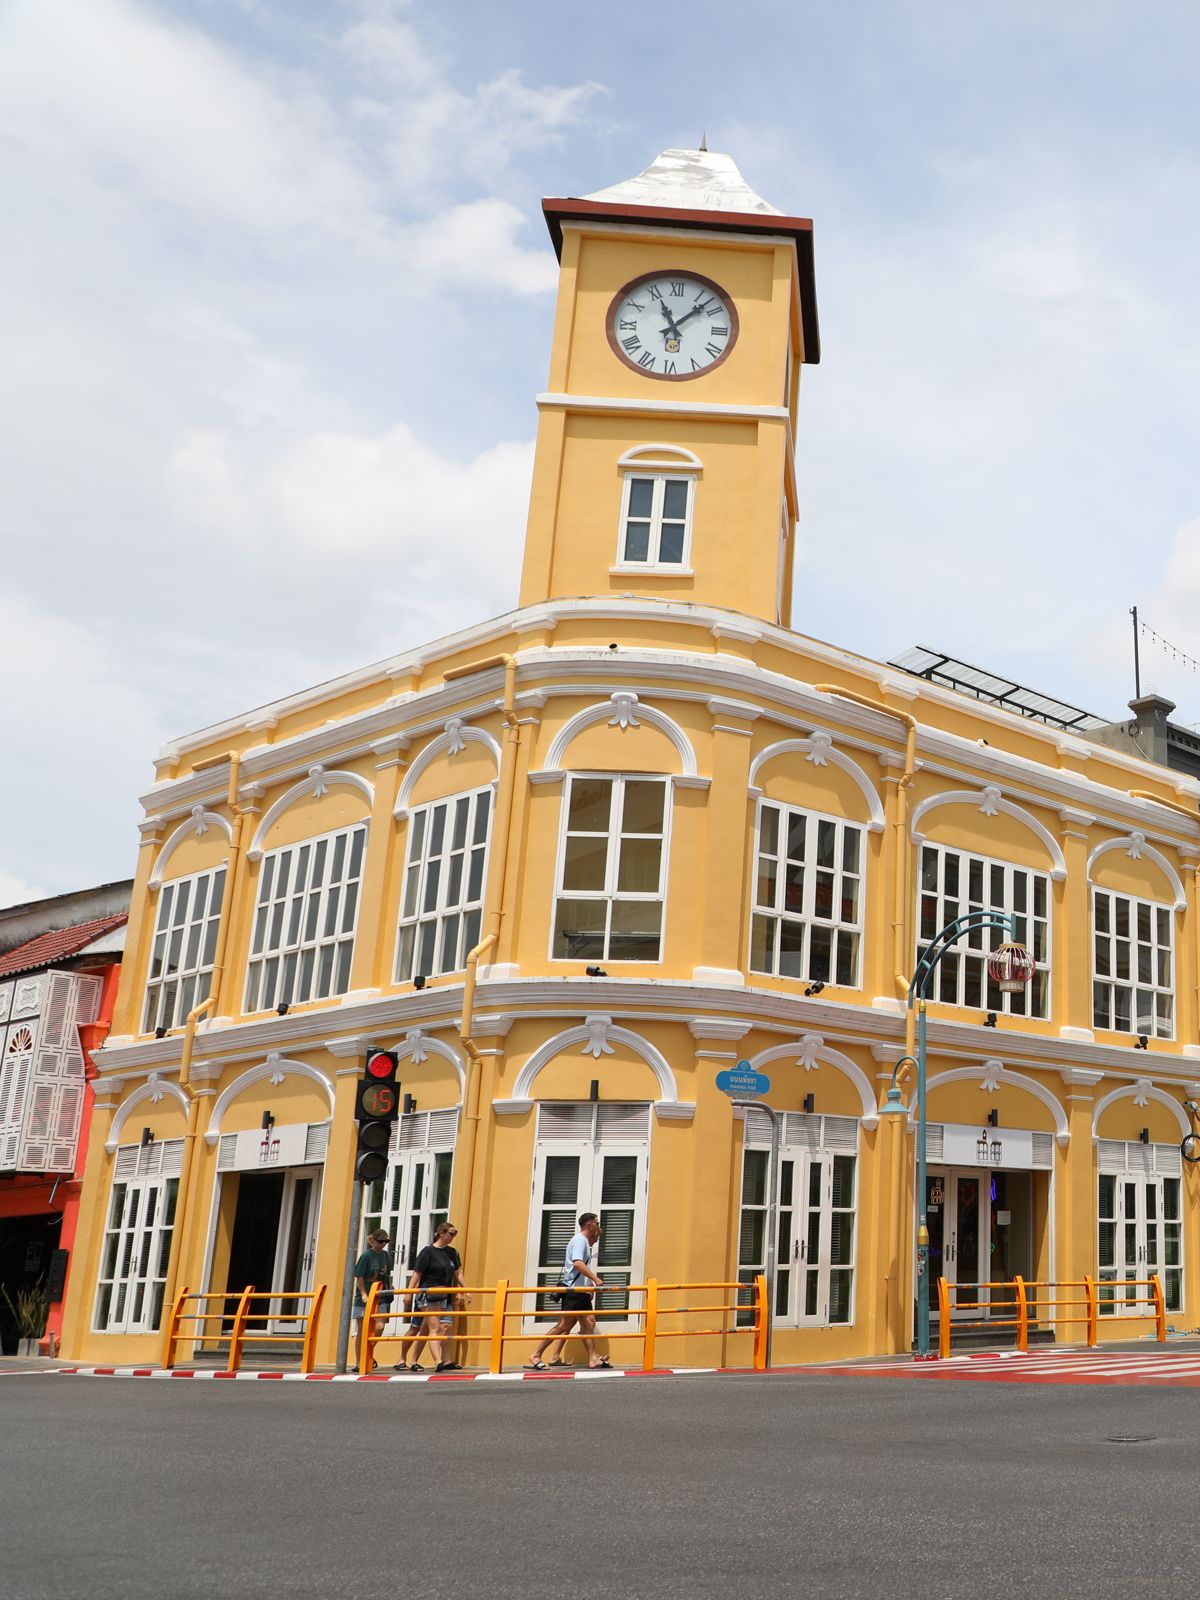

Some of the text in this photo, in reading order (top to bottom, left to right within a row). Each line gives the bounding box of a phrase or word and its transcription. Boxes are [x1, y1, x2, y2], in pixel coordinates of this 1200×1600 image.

[647, 284, 663, 301] XI
[669, 282, 685, 297] XII
[627, 299, 645, 313] X
[706, 306, 724, 317] II
[619, 319, 637, 331] IX
[711, 326, 728, 337] III
[371, 1089, 391, 1112] 15
